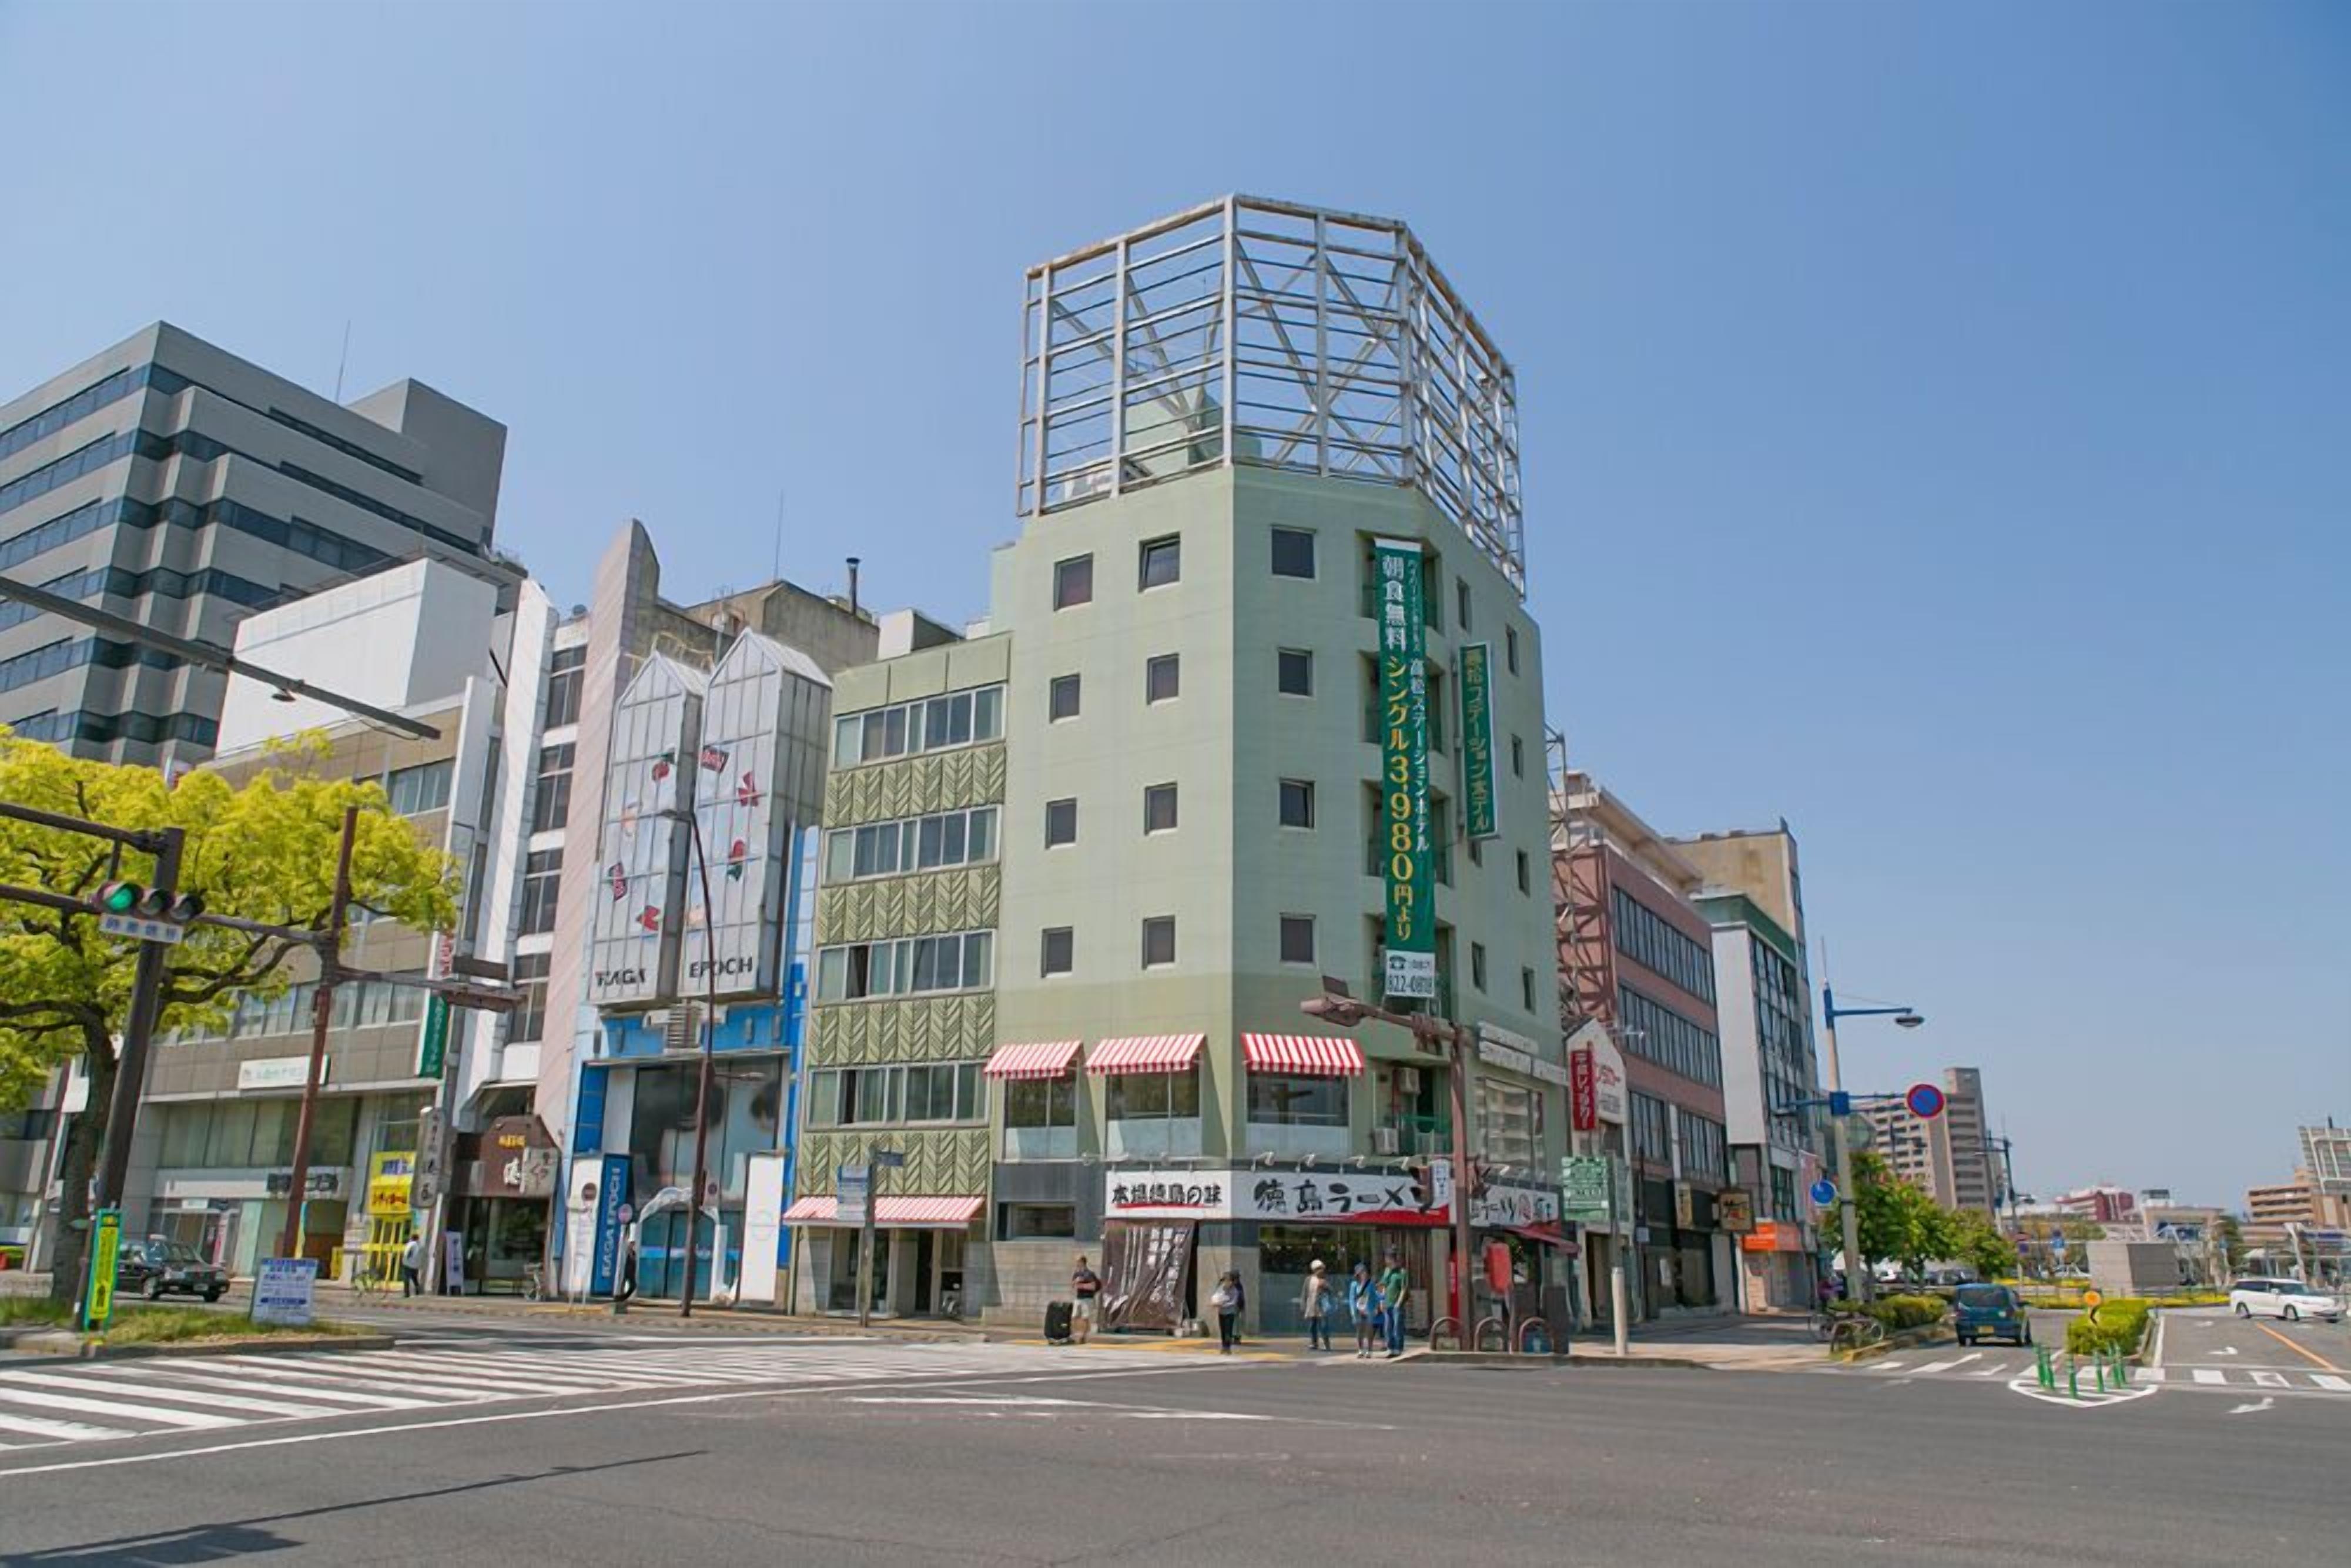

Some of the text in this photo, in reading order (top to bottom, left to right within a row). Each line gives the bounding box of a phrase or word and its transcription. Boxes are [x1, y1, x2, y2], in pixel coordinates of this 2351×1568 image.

[1253, 1178, 1434, 1213] 徳島ラーメ
